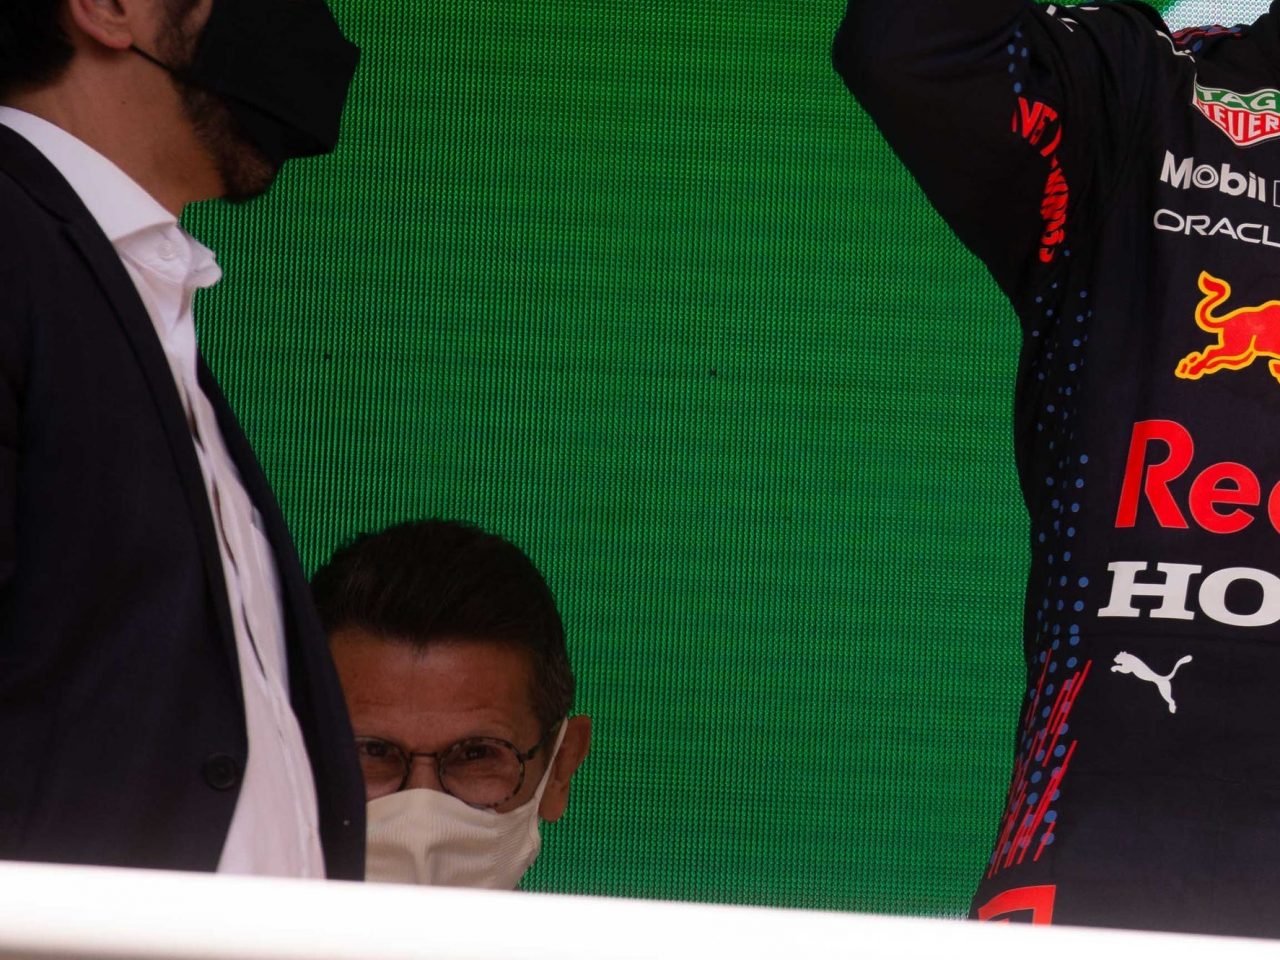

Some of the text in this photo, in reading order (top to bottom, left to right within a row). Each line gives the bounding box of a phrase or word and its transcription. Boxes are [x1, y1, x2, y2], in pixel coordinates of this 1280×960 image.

[1201, 89, 1277, 111] TAG
[1200, 104, 1280, 141] HEUER
[1159, 149, 1266, 203] Mobil
